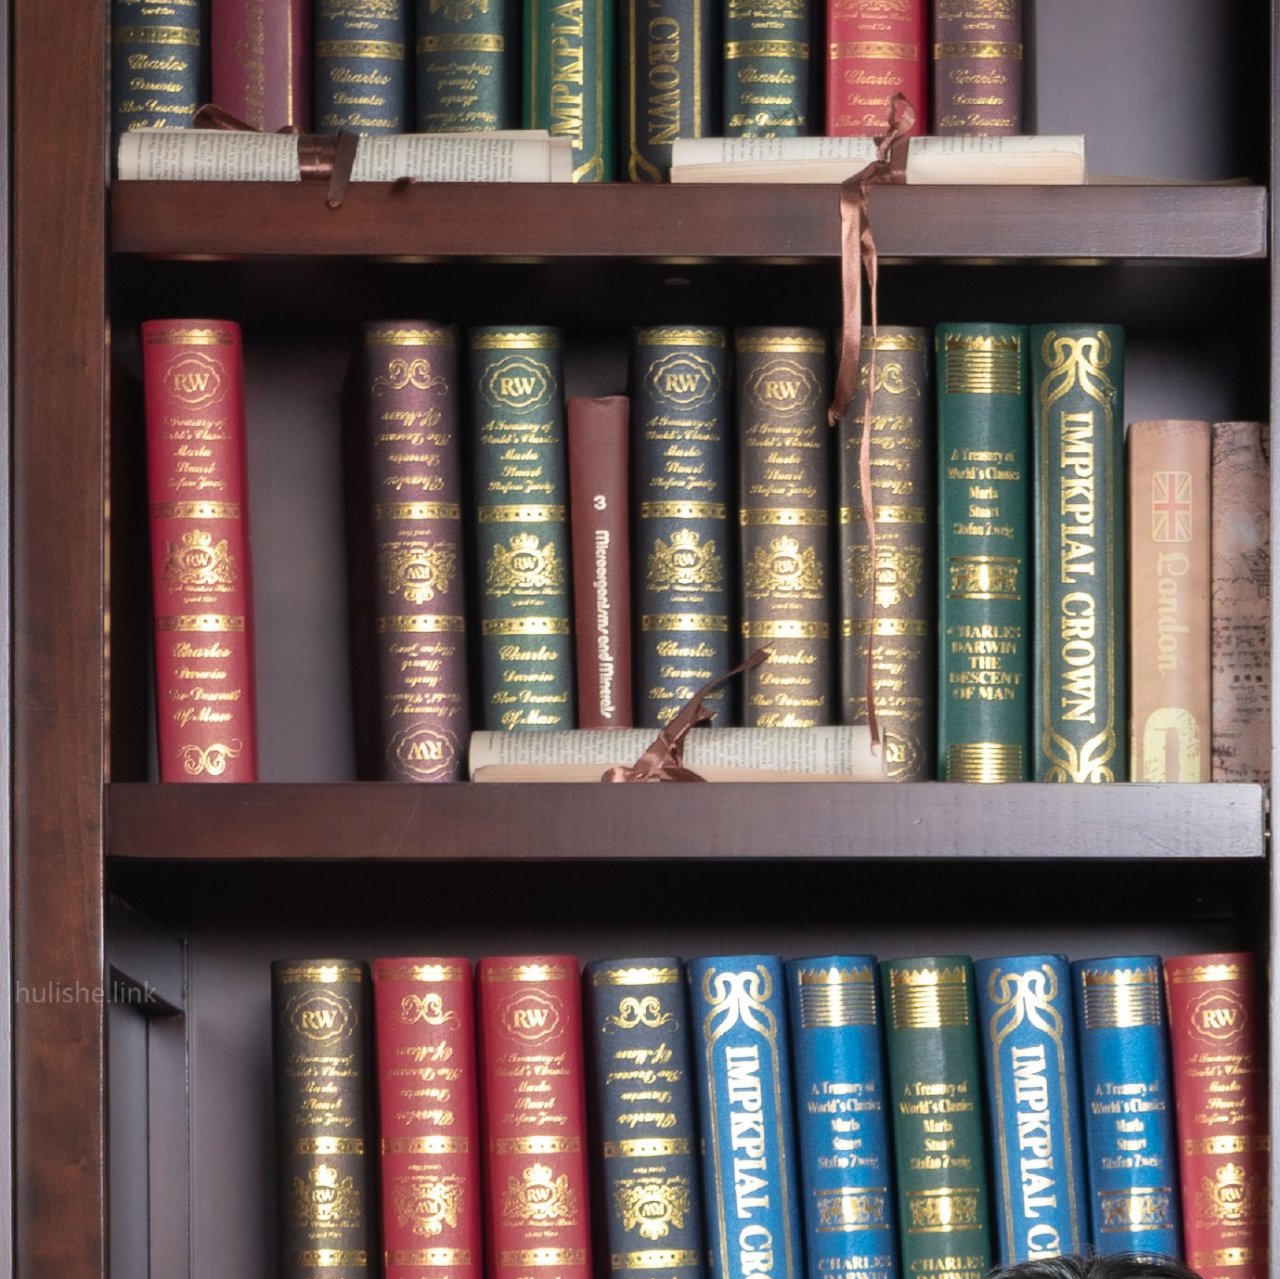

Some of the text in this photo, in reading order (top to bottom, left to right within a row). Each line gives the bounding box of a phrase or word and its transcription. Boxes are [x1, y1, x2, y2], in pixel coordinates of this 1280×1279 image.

[649, 17, 681, 145] CROWN
[174, 373, 210, 393] RW
[500, 377, 536, 397] RW
[666, 374, 701, 393] RW
[766, 381, 801, 401] RW
[593, 494, 616, 719] 3 Microorganisms and Minerals
[1157, 551, 1191, 676] London
[951, 640, 1017, 654] DARWIN
[967, 655, 1002, 670] THE
[1061, 592, 1096, 724] CROWN
[953, 686, 1016, 701] OF MAN
[407, 740, 443, 760] RW
[302, 1009, 338, 1030] RW
[513, 1008, 549, 1029] RW
[1202, 1008, 1237, 1029] RW
[911, 1255, 985, 1271] CHARLES
